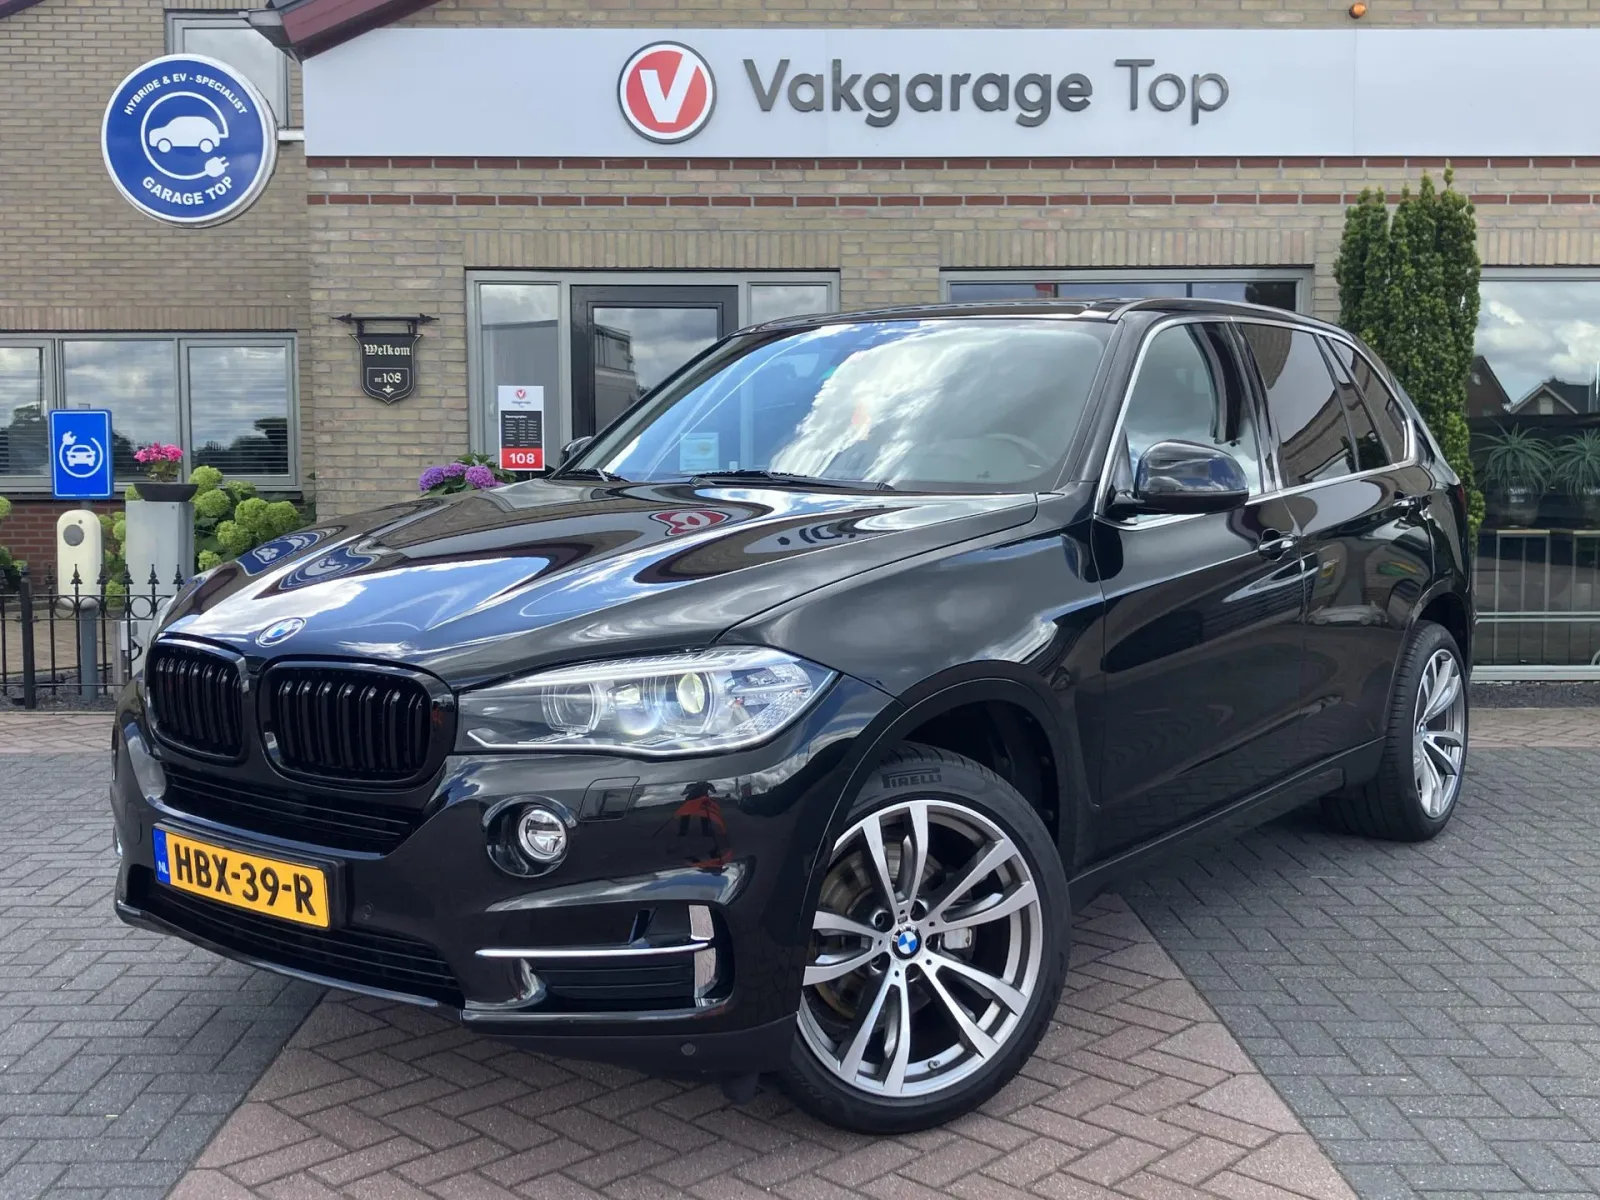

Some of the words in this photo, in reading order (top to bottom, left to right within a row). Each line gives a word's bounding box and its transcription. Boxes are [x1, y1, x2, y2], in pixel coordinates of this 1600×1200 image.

[124, 79, 161, 115] HYBRIDE
[162, 75, 171, 85] &
[172, 73, 187, 83] EV
[195, 74, 248, 114] SPECIALIST
[742, 58, 1094, 128] Vakgarage
[1114, 58, 1230, 126] Top
[142, 176, 205, 206] GARAGE
[205, 176, 233, 200] TOP
[364, 344, 411, 356] Welkom
[382, 372, 402, 384] 108
[509, 452, 536, 465] 108
[882, 768, 942, 789] PIRELLI
[158, 861, 169, 875] NL
[174, 843, 317, 917] HBX-39-R
